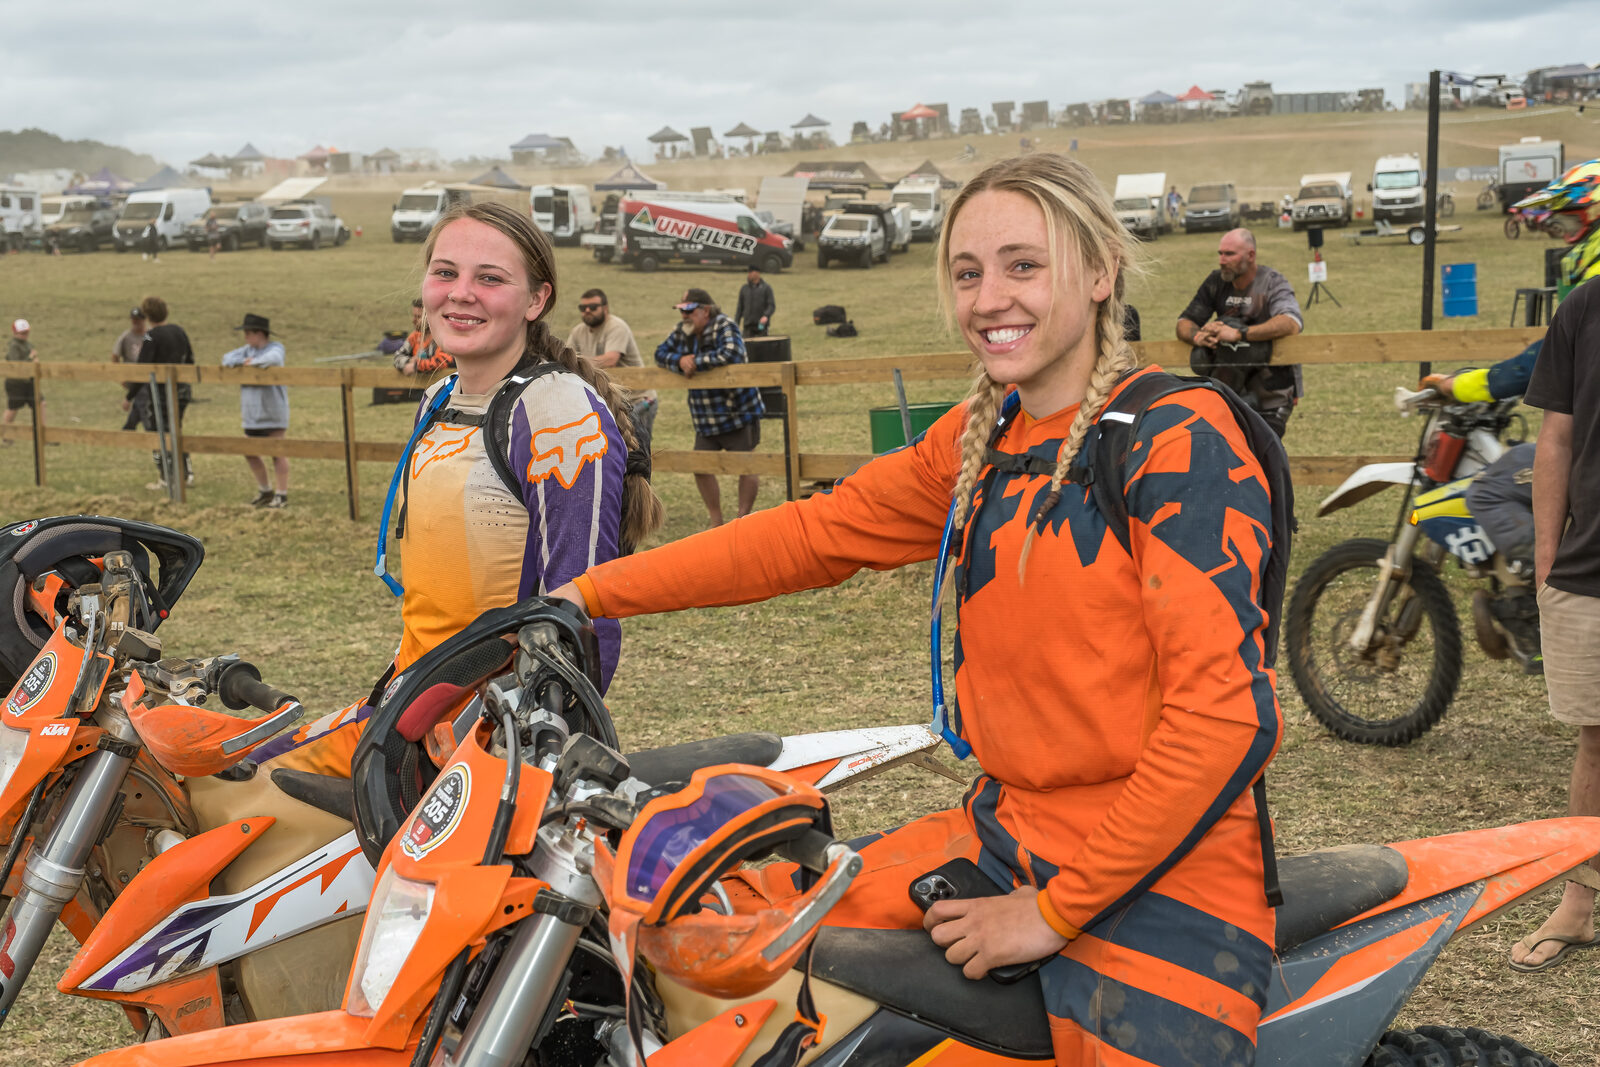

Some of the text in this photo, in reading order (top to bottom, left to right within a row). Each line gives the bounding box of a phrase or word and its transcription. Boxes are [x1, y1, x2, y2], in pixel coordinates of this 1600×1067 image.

[656, 216, 694, 239] UNI
[695, 227, 756, 253] FILTER
[24, 673, 41, 692] 205
[40, 723, 70, 736] KTM
[423, 796, 449, 824] 205
[176, 996, 212, 1019] KTM
